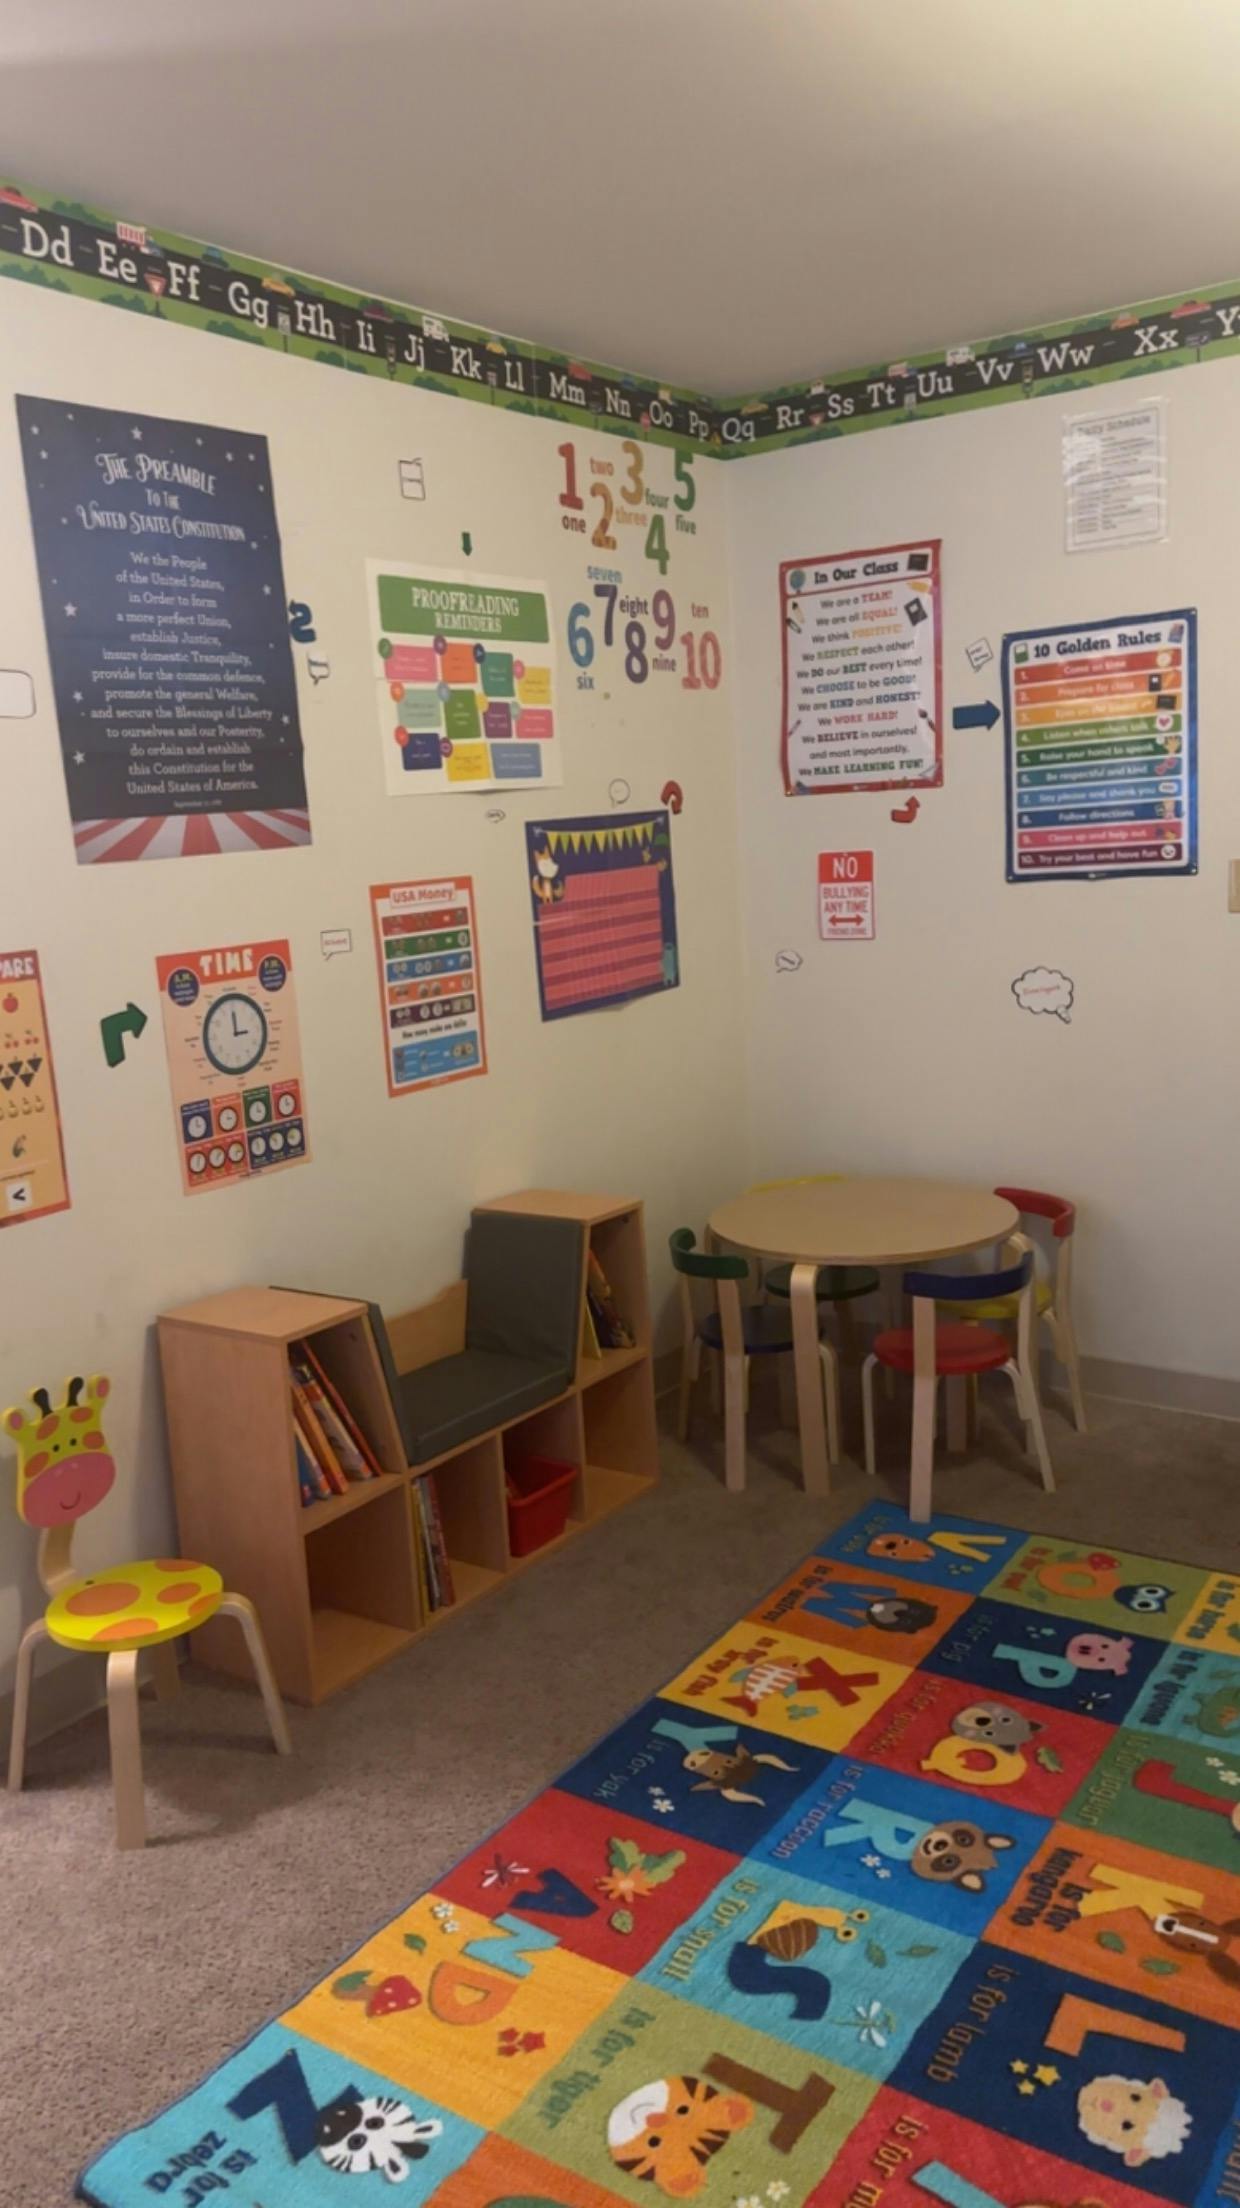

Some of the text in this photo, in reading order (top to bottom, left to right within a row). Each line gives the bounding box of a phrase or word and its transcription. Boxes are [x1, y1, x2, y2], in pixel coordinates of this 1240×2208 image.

[20, 218, 708, 442] Dd Ee Ff Gg Hh Ii Jj Kk Ll Mm Nn Oo Pp
[722, 306, 1240, 444] Qq Rr Ss Tt Uu Vv Ww Xx Y
[558, 442, 584, 511] 1
[590, 458, 614, 477] two
[620, 440, 644, 505] 3
[674, 449, 696, 512] 5
[645, 488, 670, 509] four
[562, 514, 586, 533] one
[590, 482, 617, 550] 2
[615, 506, 647, 527] three
[675, 514, 696, 534] five
[644, 514, 670, 576] 4
[130, 552, 207, 571] We the People
[587, 565, 623, 583] seven
[814, 561, 899, 585] In Our Class
[116, 570, 225, 591] of the United States,
[129, 590, 218, 609] in Order to form
[412, 587, 519, 617] PROOFREADING
[619, 597, 649, 618] eight
[691, 602, 709, 618] ten
[821, 600, 834, 608] We
[836, 598, 851, 607] are
[861, 590, 893, 603] TEAM!
[117, 611, 232, 630] a more perfect Union,
[435, 612, 502, 633] REMINDERS
[594, 584, 618, 647] 7
[652, 589, 676, 651] 9
[568, 602, 594, 668] 6
[1034, 630, 1161, 658] 10 Golden Rules
[624, 621, 648, 684] 8
[652, 655, 676, 672] nine
[680, 631, 722, 690] 10
[92, 667, 265, 684] provide for the common defence,
[577, 672, 594, 690] six
[797, 656, 922, 679] We DO our BEST every time!
[798, 703, 811, 711] We
[813, 702, 827, 710] are
[830, 698, 853, 709] KIND
[856, 697, 873, 706] and
[818, 710, 898, 726] We WORK HARD!
[799, 768, 812, 776] We
[814, 765, 840, 775] MAKE
[844, 761, 895, 774] LEARNING
[127, 779, 258, 795] United States of America.
[1059, 811, 1087, 821] Follow
[1089, 808, 1135, 820] directions
[832, 856, 858, 879] NO
[1039, 855, 1054, 864] Try
[1055, 854, 1073, 864] your
[1075, 851, 1095, 861] best
[1097, 851, 1115, 860] and
[1117, 849, 1140, 859] have
[1142, 849, 1158, 857] fun
[393, 887, 454, 904] USA Money
[823, 886, 869, 899] BULLYING
[824, 900, 868, 913] ANY TIME
[0, 957, 34, 979] ARE
[200, 948, 253, 976] TIME
[928, 1530, 1007, 1563] V
[992, 1642, 1078, 1689] P
[796, 1656, 879, 1708] X
[650, 1718, 739, 1757] Y
[921, 1734, 1028, 1787] Q
[828, 1780, 857, 1800] for
[771, 1801, 834, 1859] raccoon
[824, 1797, 936, 1860] R
[1010, 1847, 1083, 1927] kangaroo
[1079, 1864, 1204, 1921] K
[712, 1896, 750, 1928] for
[1043, 1881, 1093, 1933] is for
[662, 1927, 716, 1982] snail
[727, 1941, 832, 2022] S
[926, 1963, 1020, 2083] is for lamb
[1043, 1993, 1187, 2058] L
[537, 2007, 657, 2129] is for tiger
[225, 2048, 367, 2166] Z
[703, 2052, 836, 2155] T
[144, 2130, 228, 2194] zebra
[182, 2148, 258, 2208] is for
